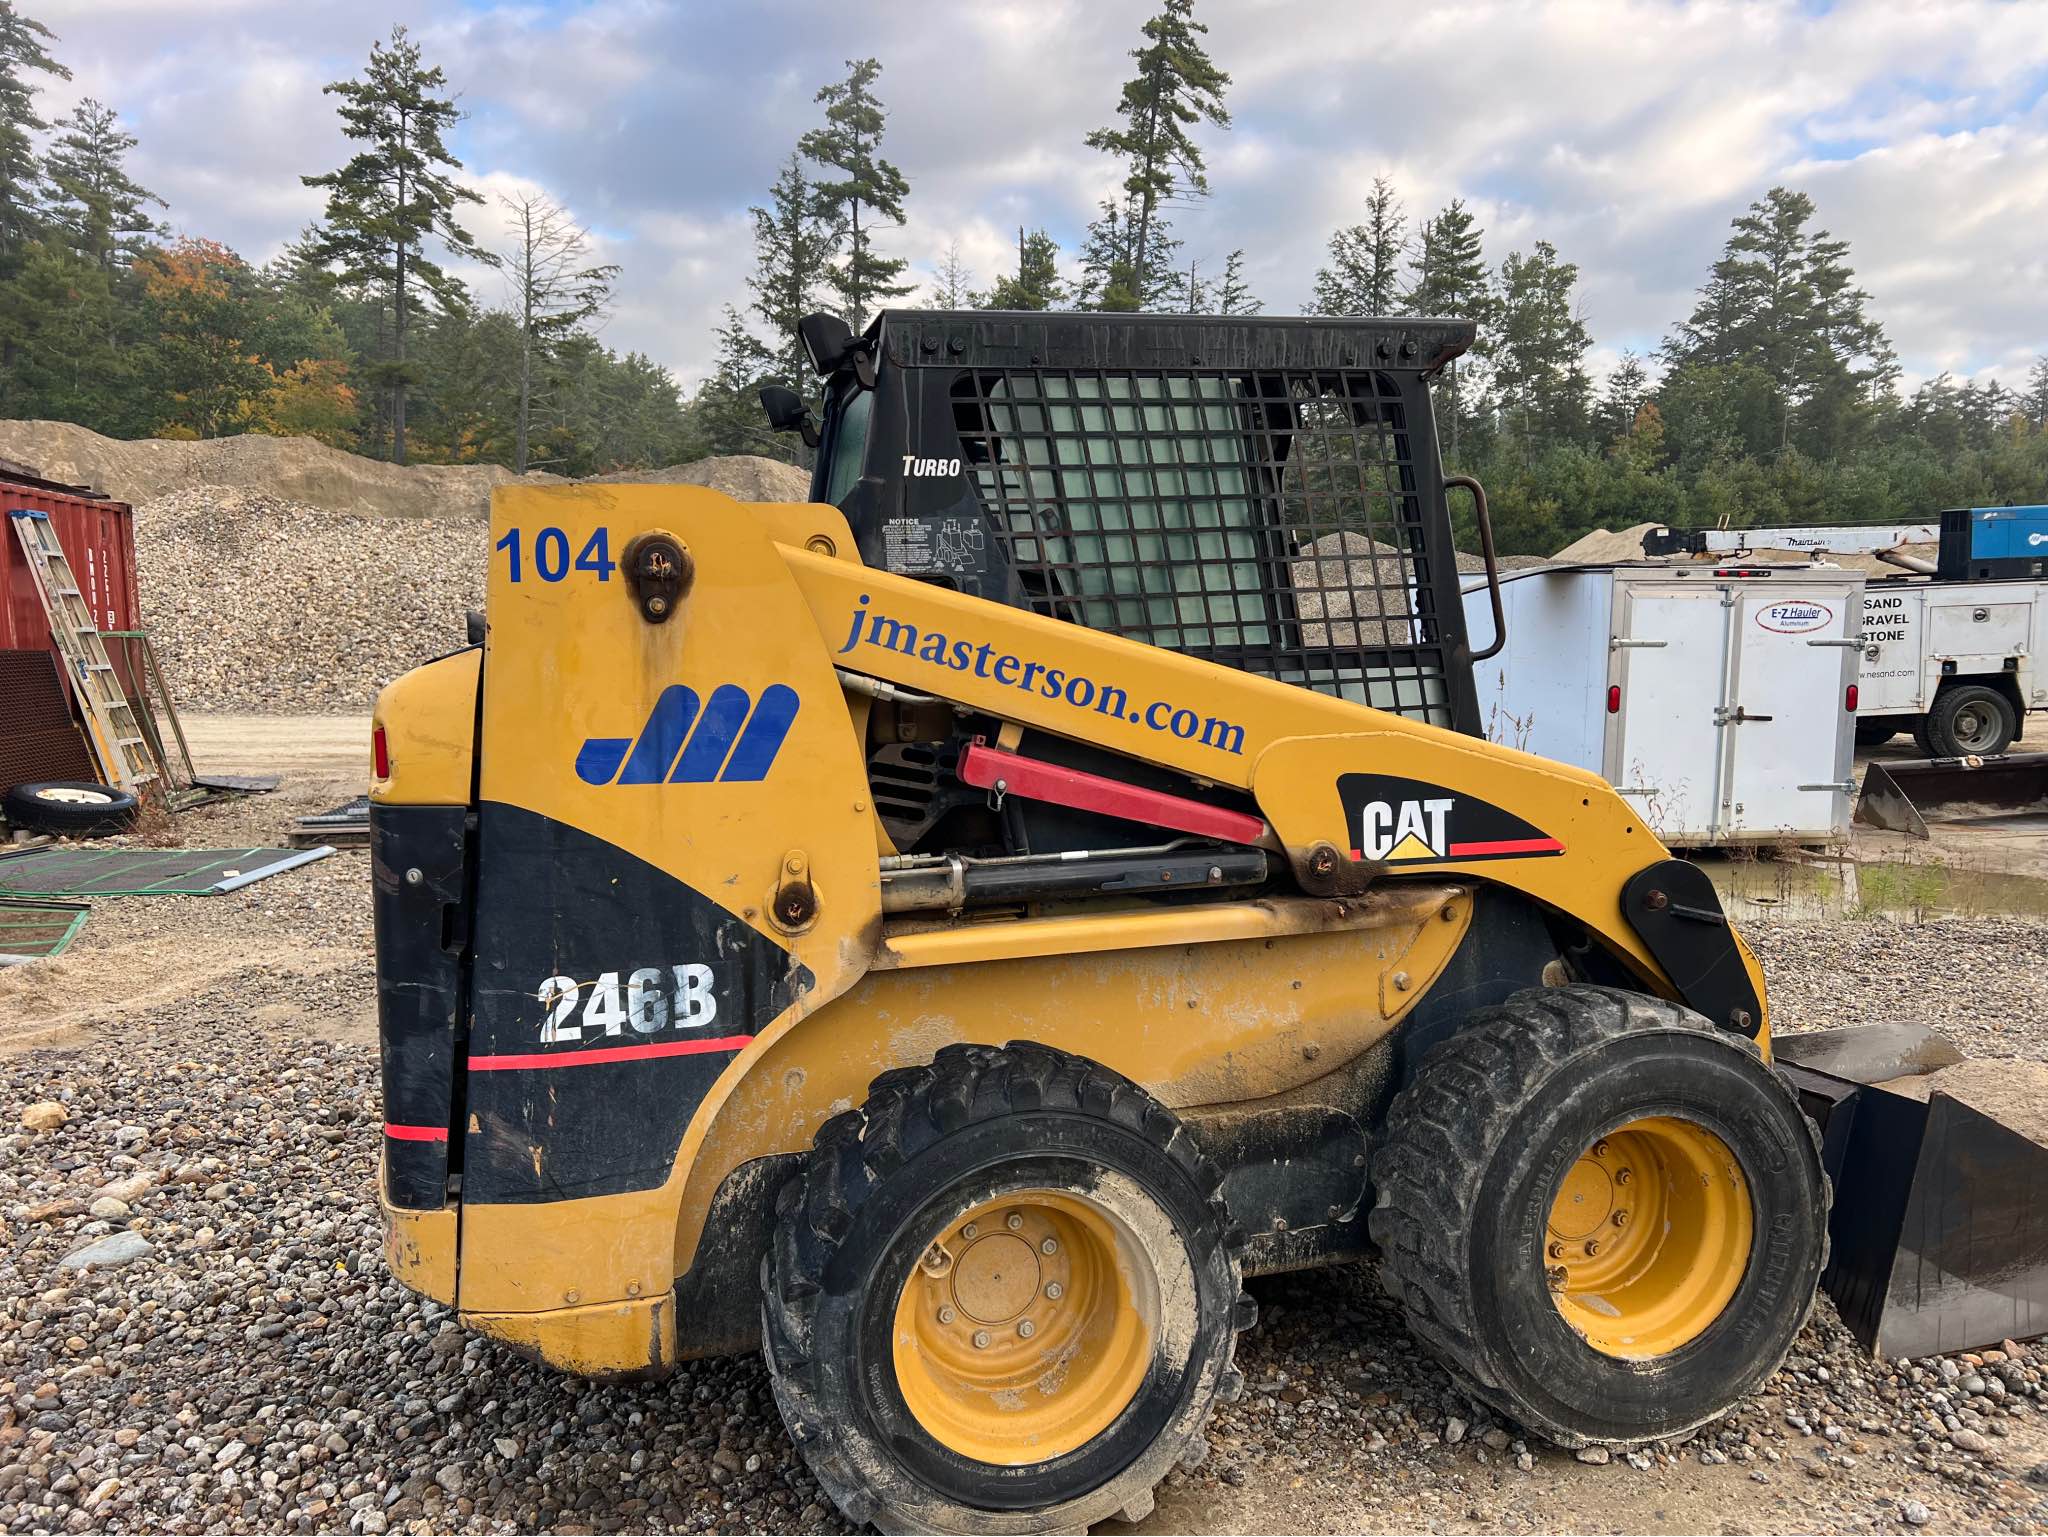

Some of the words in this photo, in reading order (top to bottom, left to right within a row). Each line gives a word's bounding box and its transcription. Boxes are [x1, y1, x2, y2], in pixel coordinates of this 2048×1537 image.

[902, 455, 961, 477] TURBO
[496, 527, 616, 583] 104
[1771, 608, 1788, 619] E-Z
[1789, 607, 1822, 619] Hauler
[1863, 598, 1903, 609] SAND
[838, 594, 1246, 756] jmasterson.com
[1363, 798, 1453, 861] CAT
[537, 963, 717, 1043] 246B
